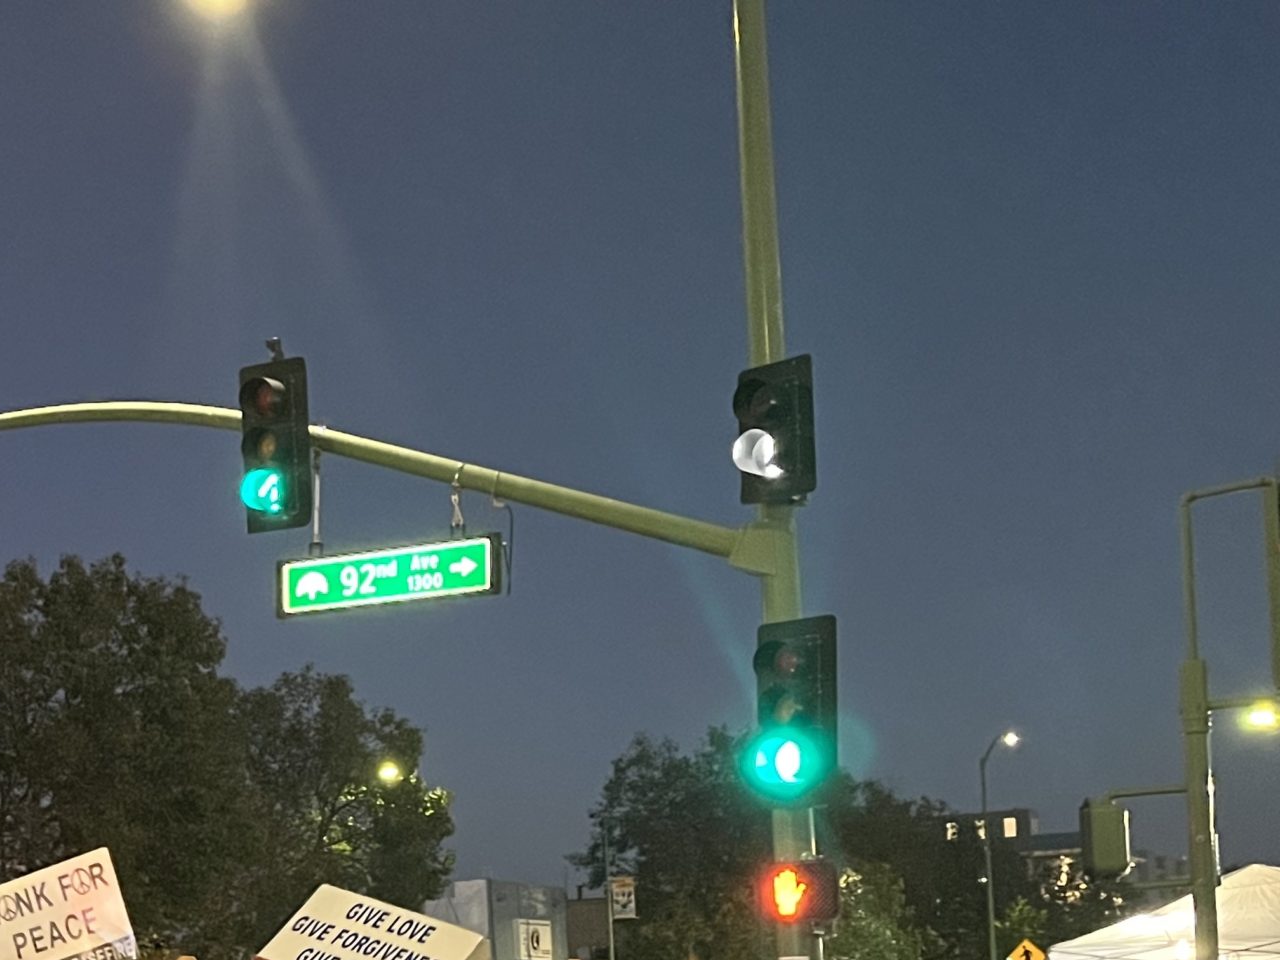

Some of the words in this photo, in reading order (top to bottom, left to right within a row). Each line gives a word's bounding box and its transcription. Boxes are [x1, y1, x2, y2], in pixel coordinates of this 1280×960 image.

[410, 554, 440, 572] Ave
[406, 571, 444, 592] 1300
[57, 862, 110, 903] FOR
[11, 906, 97, 960] PEACE
[291, 915, 337, 941] GIVE
[345, 902, 390, 929] GIVE
[385, 914, 437, 945] LOVE
